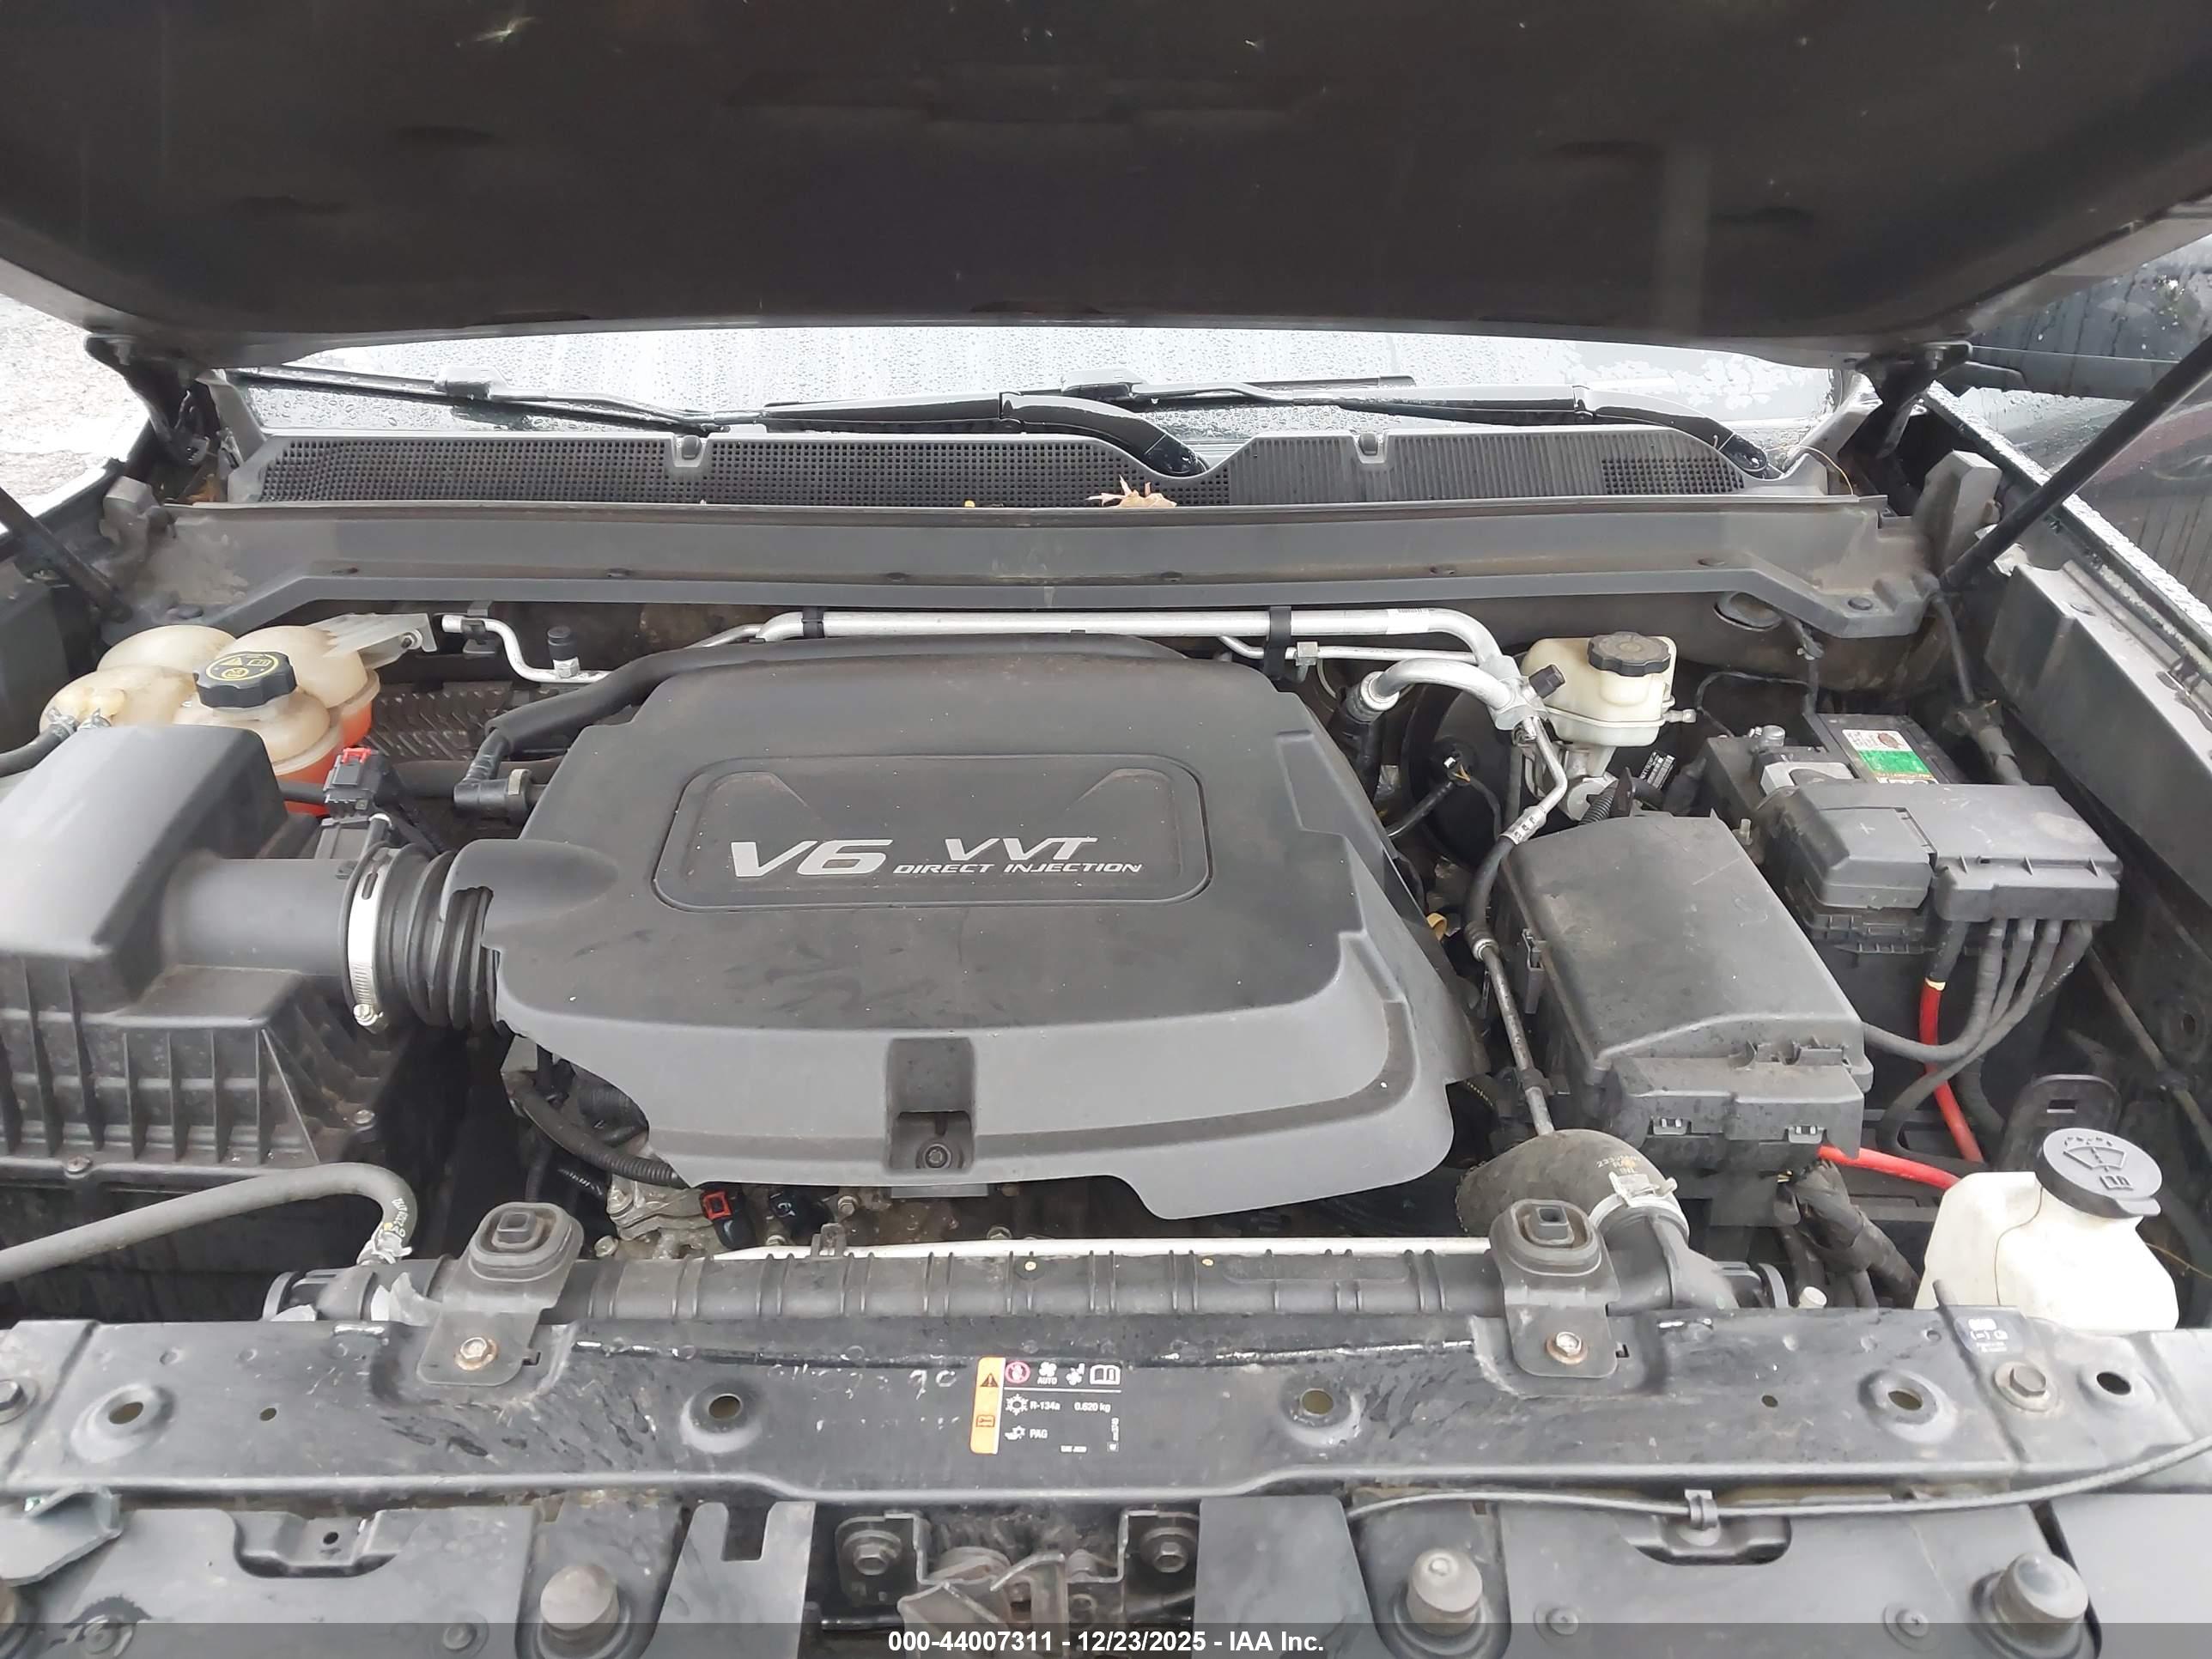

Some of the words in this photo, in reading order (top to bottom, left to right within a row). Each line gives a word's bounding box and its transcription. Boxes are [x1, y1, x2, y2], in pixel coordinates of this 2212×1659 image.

[945, 836, 1098, 861] VVT
[731, 839, 894, 878] V6
[892, 863, 995, 874] DIRECT
[1003, 862, 1144, 873] INJECTION
[1036, 1376, 1058, 1385] AUTO
[1030, 1401, 1061, 1411] R-134a
[1073, 1401, 1099, 1412] 0.620
[1099, 1402, 1111, 1414] kg
[1029, 1428, 1048, 1439] PAG
